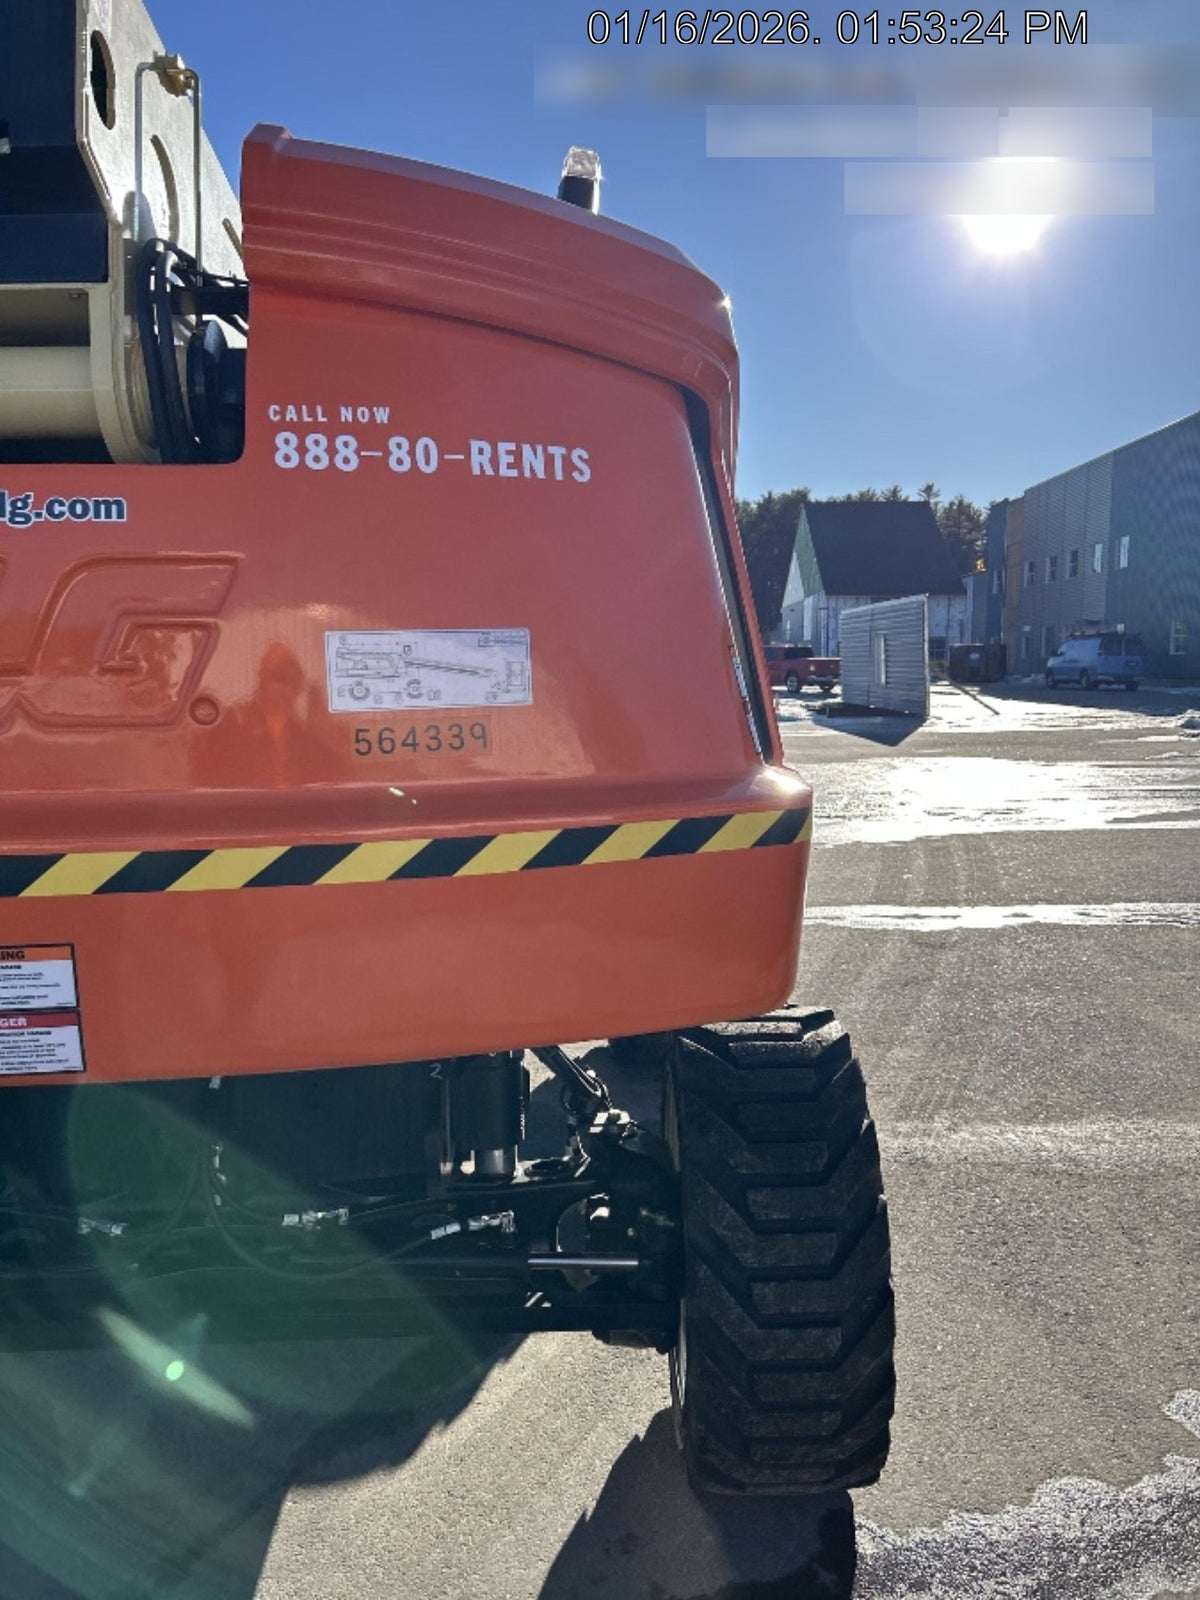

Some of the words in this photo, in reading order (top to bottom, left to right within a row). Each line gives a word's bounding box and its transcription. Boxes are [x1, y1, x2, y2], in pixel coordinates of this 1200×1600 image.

[268, 404, 328, 422] CALL
[340, 406, 391, 424] NOW
[273, 430, 592, 483] 888-80-RENTS
[354, 722, 489, 756] 564339
